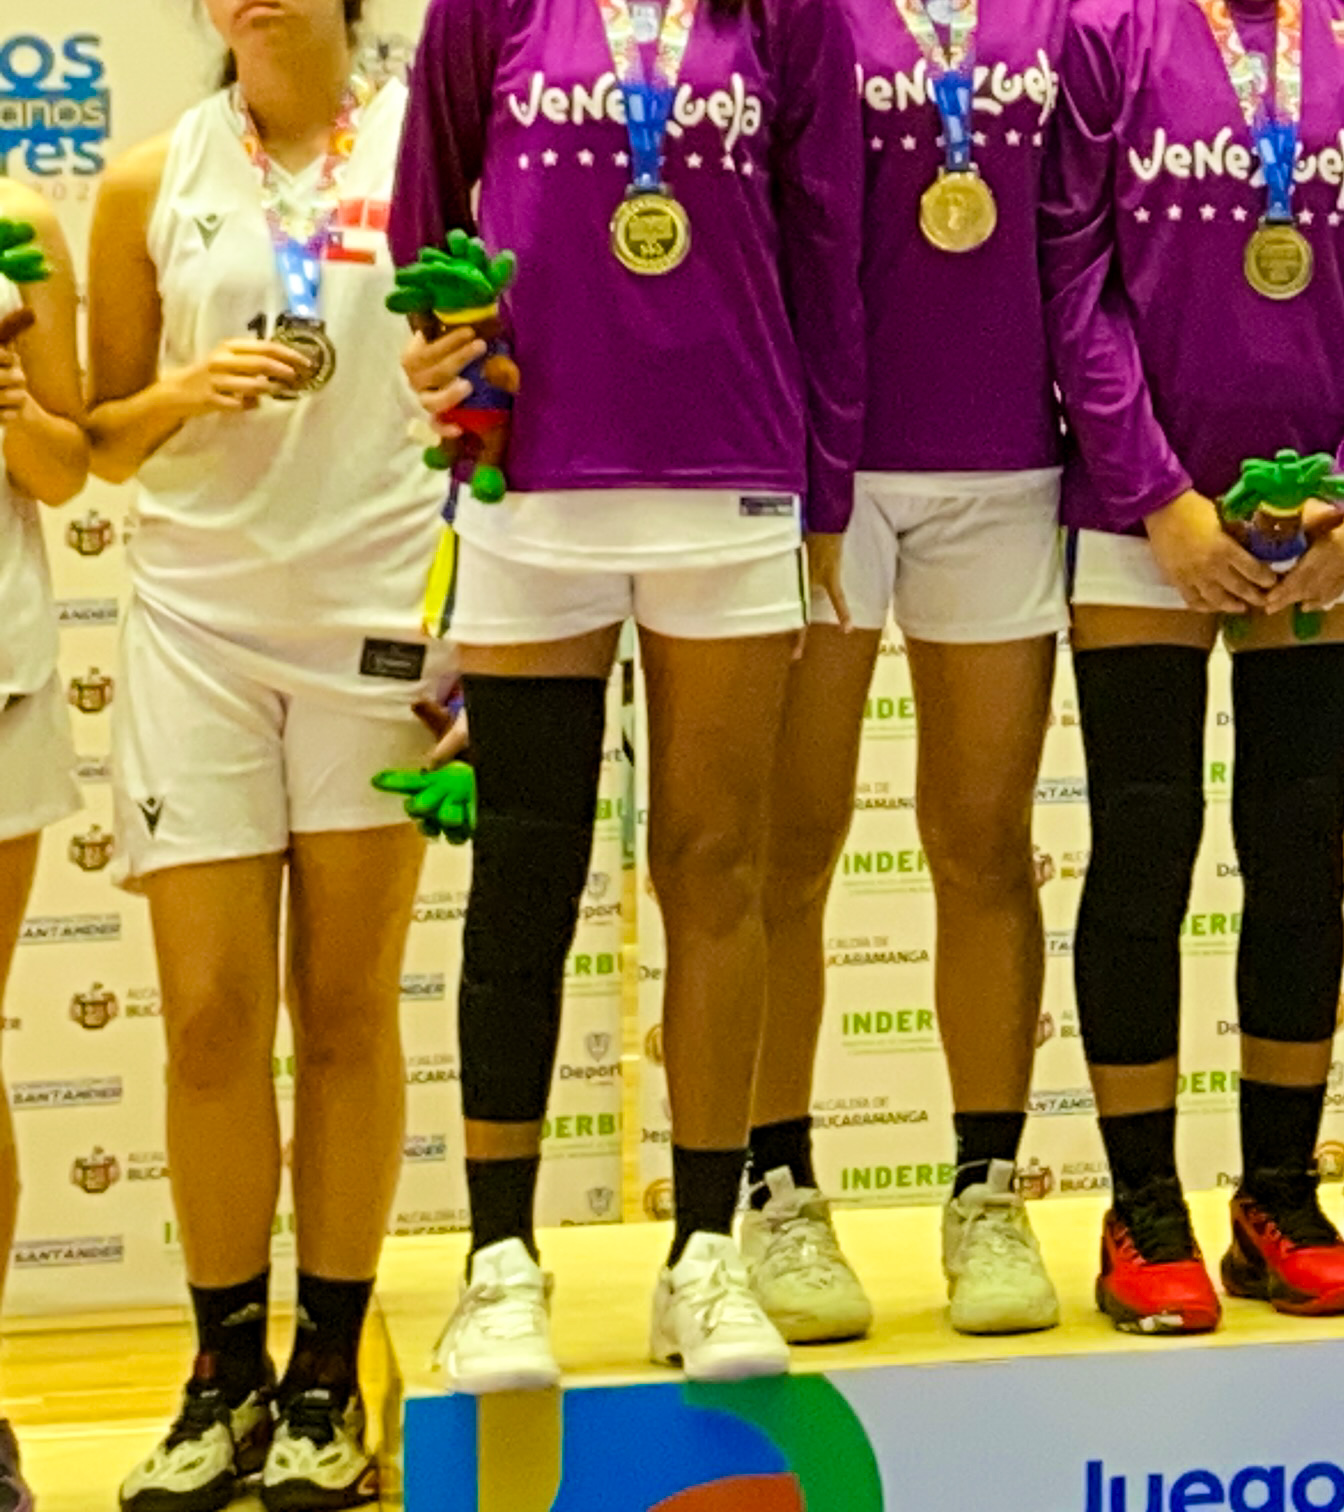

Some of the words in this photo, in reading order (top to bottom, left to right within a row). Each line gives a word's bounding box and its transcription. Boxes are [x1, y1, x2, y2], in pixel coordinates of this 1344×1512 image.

[843, 851, 926, 874] INDE
[842, 1009, 933, 1035] INDER
[842, 1163, 955, 1191] INDERB
